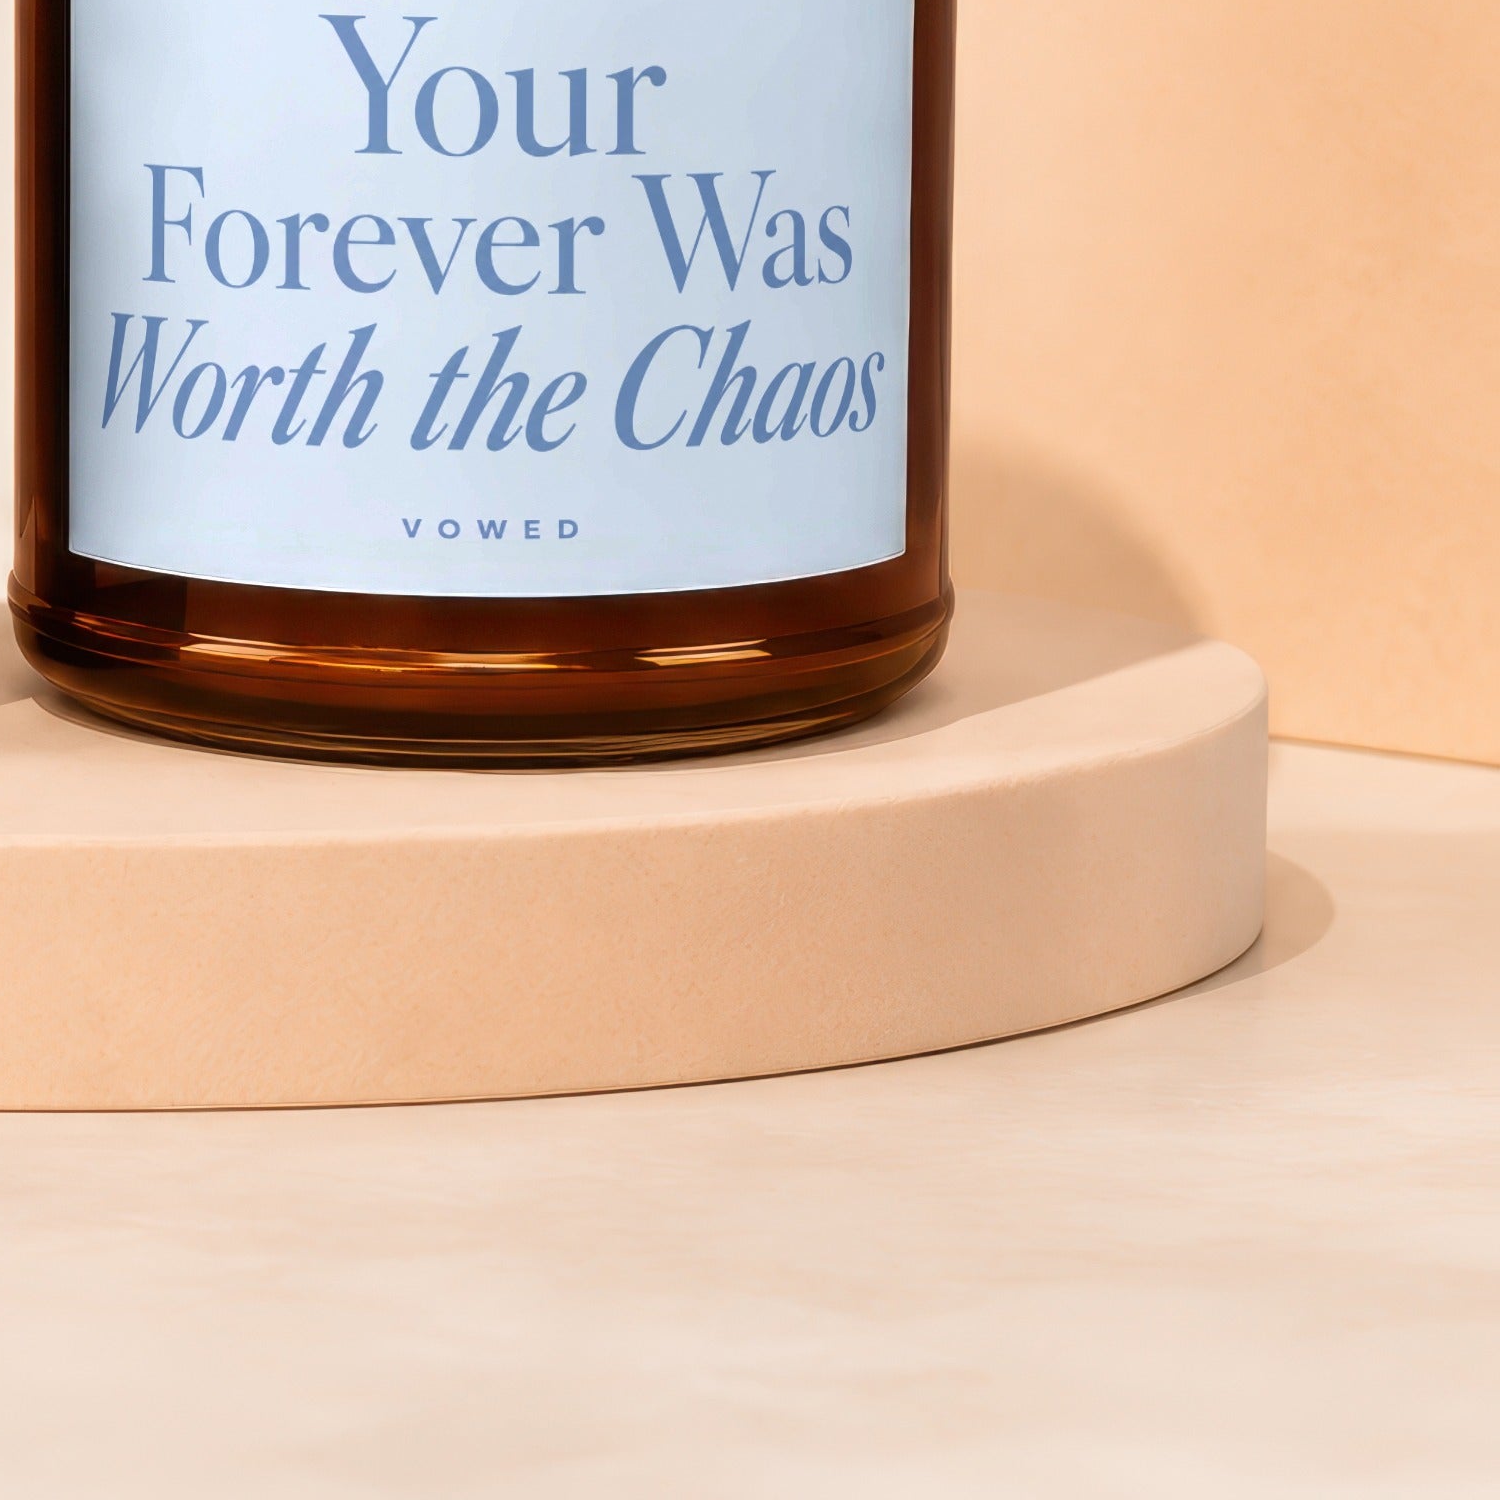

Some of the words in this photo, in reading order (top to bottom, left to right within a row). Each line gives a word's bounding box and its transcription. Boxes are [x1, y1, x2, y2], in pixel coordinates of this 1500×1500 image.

[318, 13, 667, 158] Your
[141, 162, 606, 296] Forever
[631, 168, 854, 293] Was
[100, 311, 385, 449] Worth
[409, 324, 589, 454] the
[613, 318, 886, 452] Chaos
[401, 517, 581, 541] VOWED
